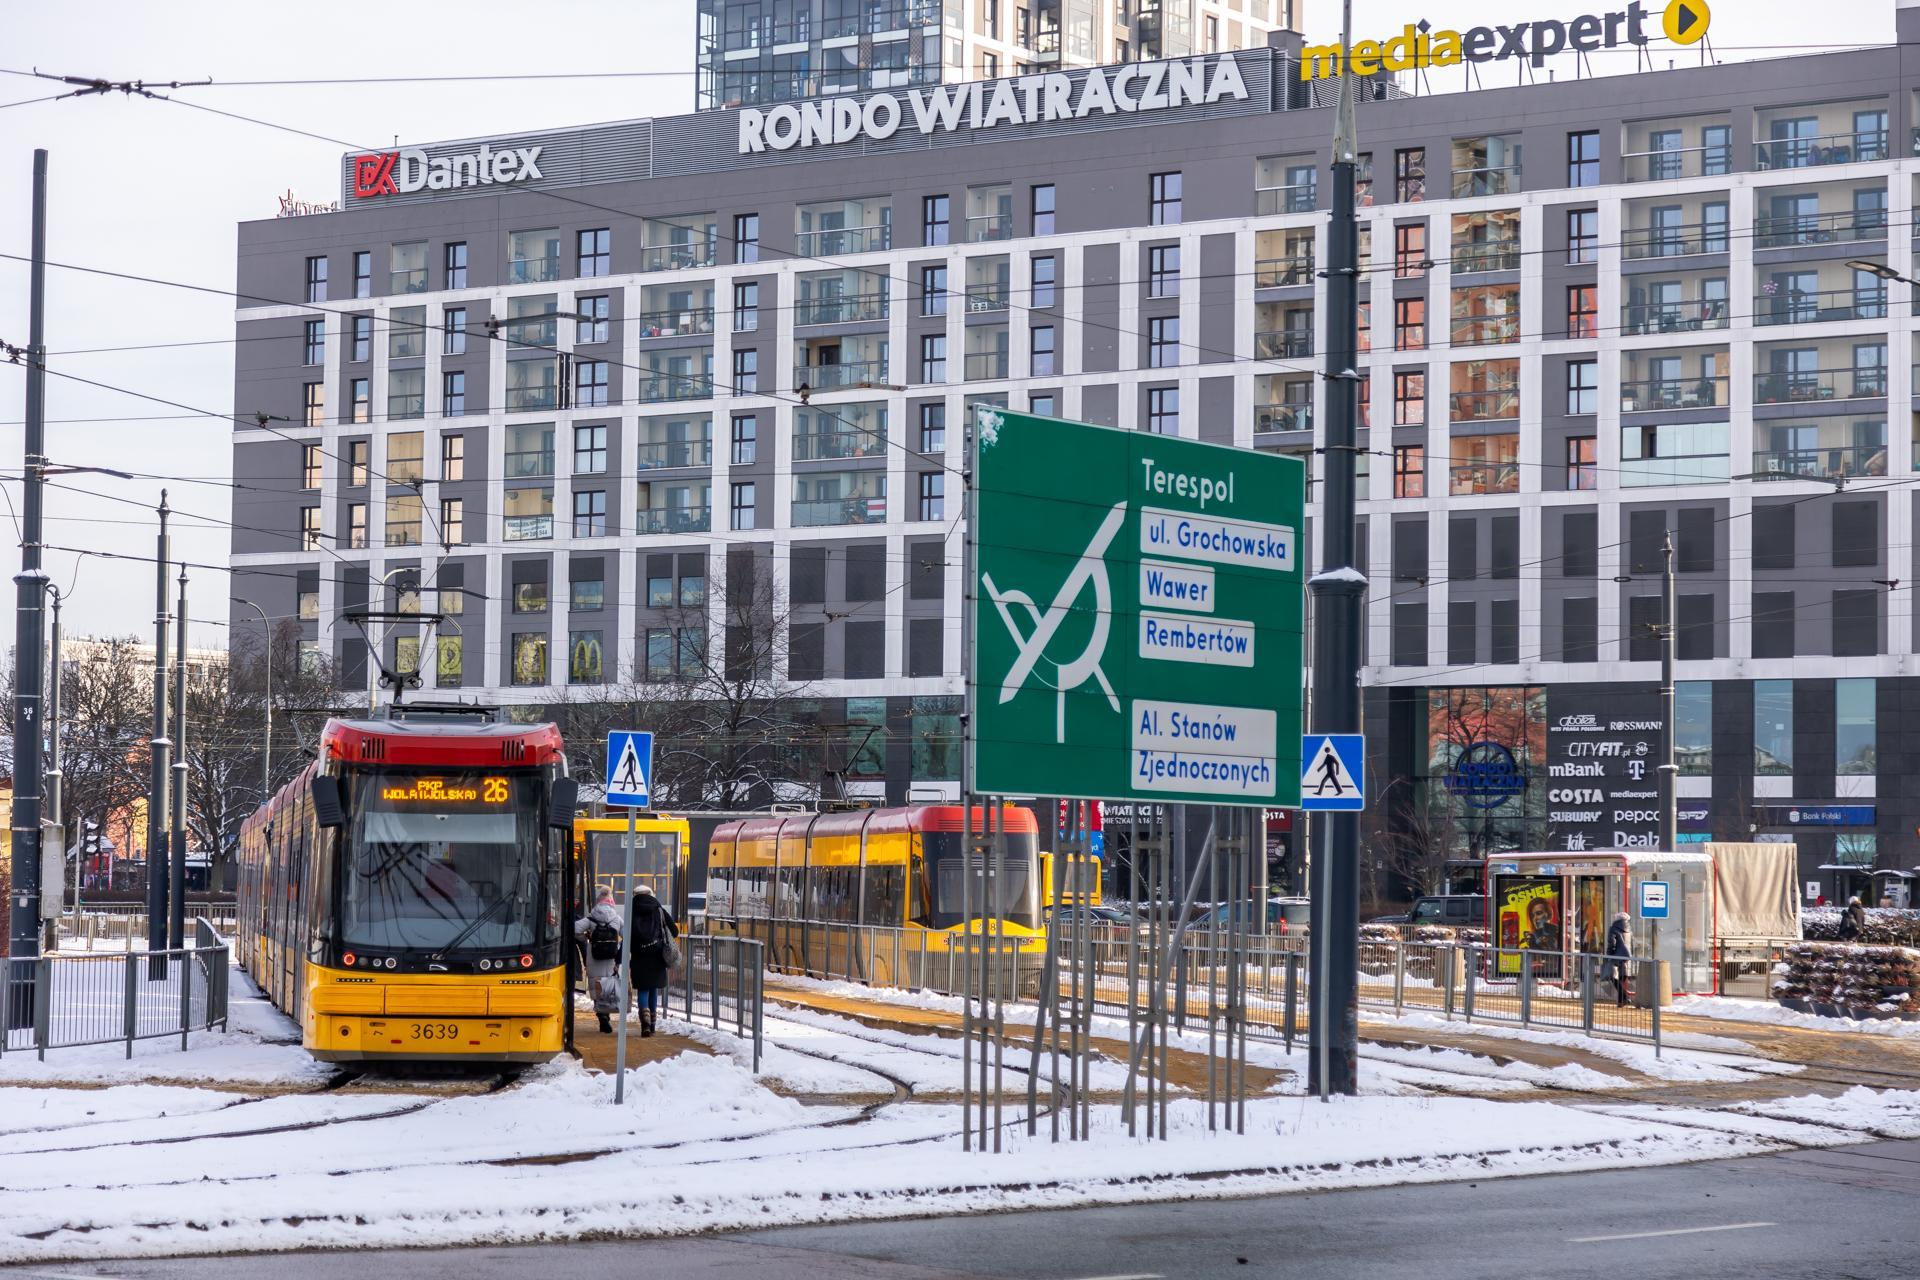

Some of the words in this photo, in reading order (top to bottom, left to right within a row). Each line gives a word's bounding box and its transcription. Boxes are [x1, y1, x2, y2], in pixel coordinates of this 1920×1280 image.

[1301, 1, 1648, 81] mediaexpert
[738, 93, 901, 154] RONDO
[907, 53, 1249, 134] WIATRACZNA
[400, 144, 543, 193] Dantex
[1142, 458, 1234, 509] Terespol
[1150, 519, 1170, 544] ul.
[1178, 521, 1286, 559] Grochowska
[1147, 570, 1208, 601] Wawer
[1147, 619, 1248, 654] Rembertów
[23, 707, 33, 715] 36
[1140, 710, 1163, 736] Al.
[1171, 712, 1236, 741] Stanów
[1139, 750, 1269, 789] Zjednoczonych
[1549, 762, 1605, 777] mBank
[417, 781, 443, 790] PKP
[484, 778, 508, 802] 26
[1549, 789, 1604, 804] COSTA
[1610, 790, 1658, 799] mediaexpert
[1549, 811, 1602, 822] SUBWAY
[1803, 812, 1820, 820] Bank
[1567, 831, 1586, 851] kik
[410, 1023, 459, 1040] 3639
